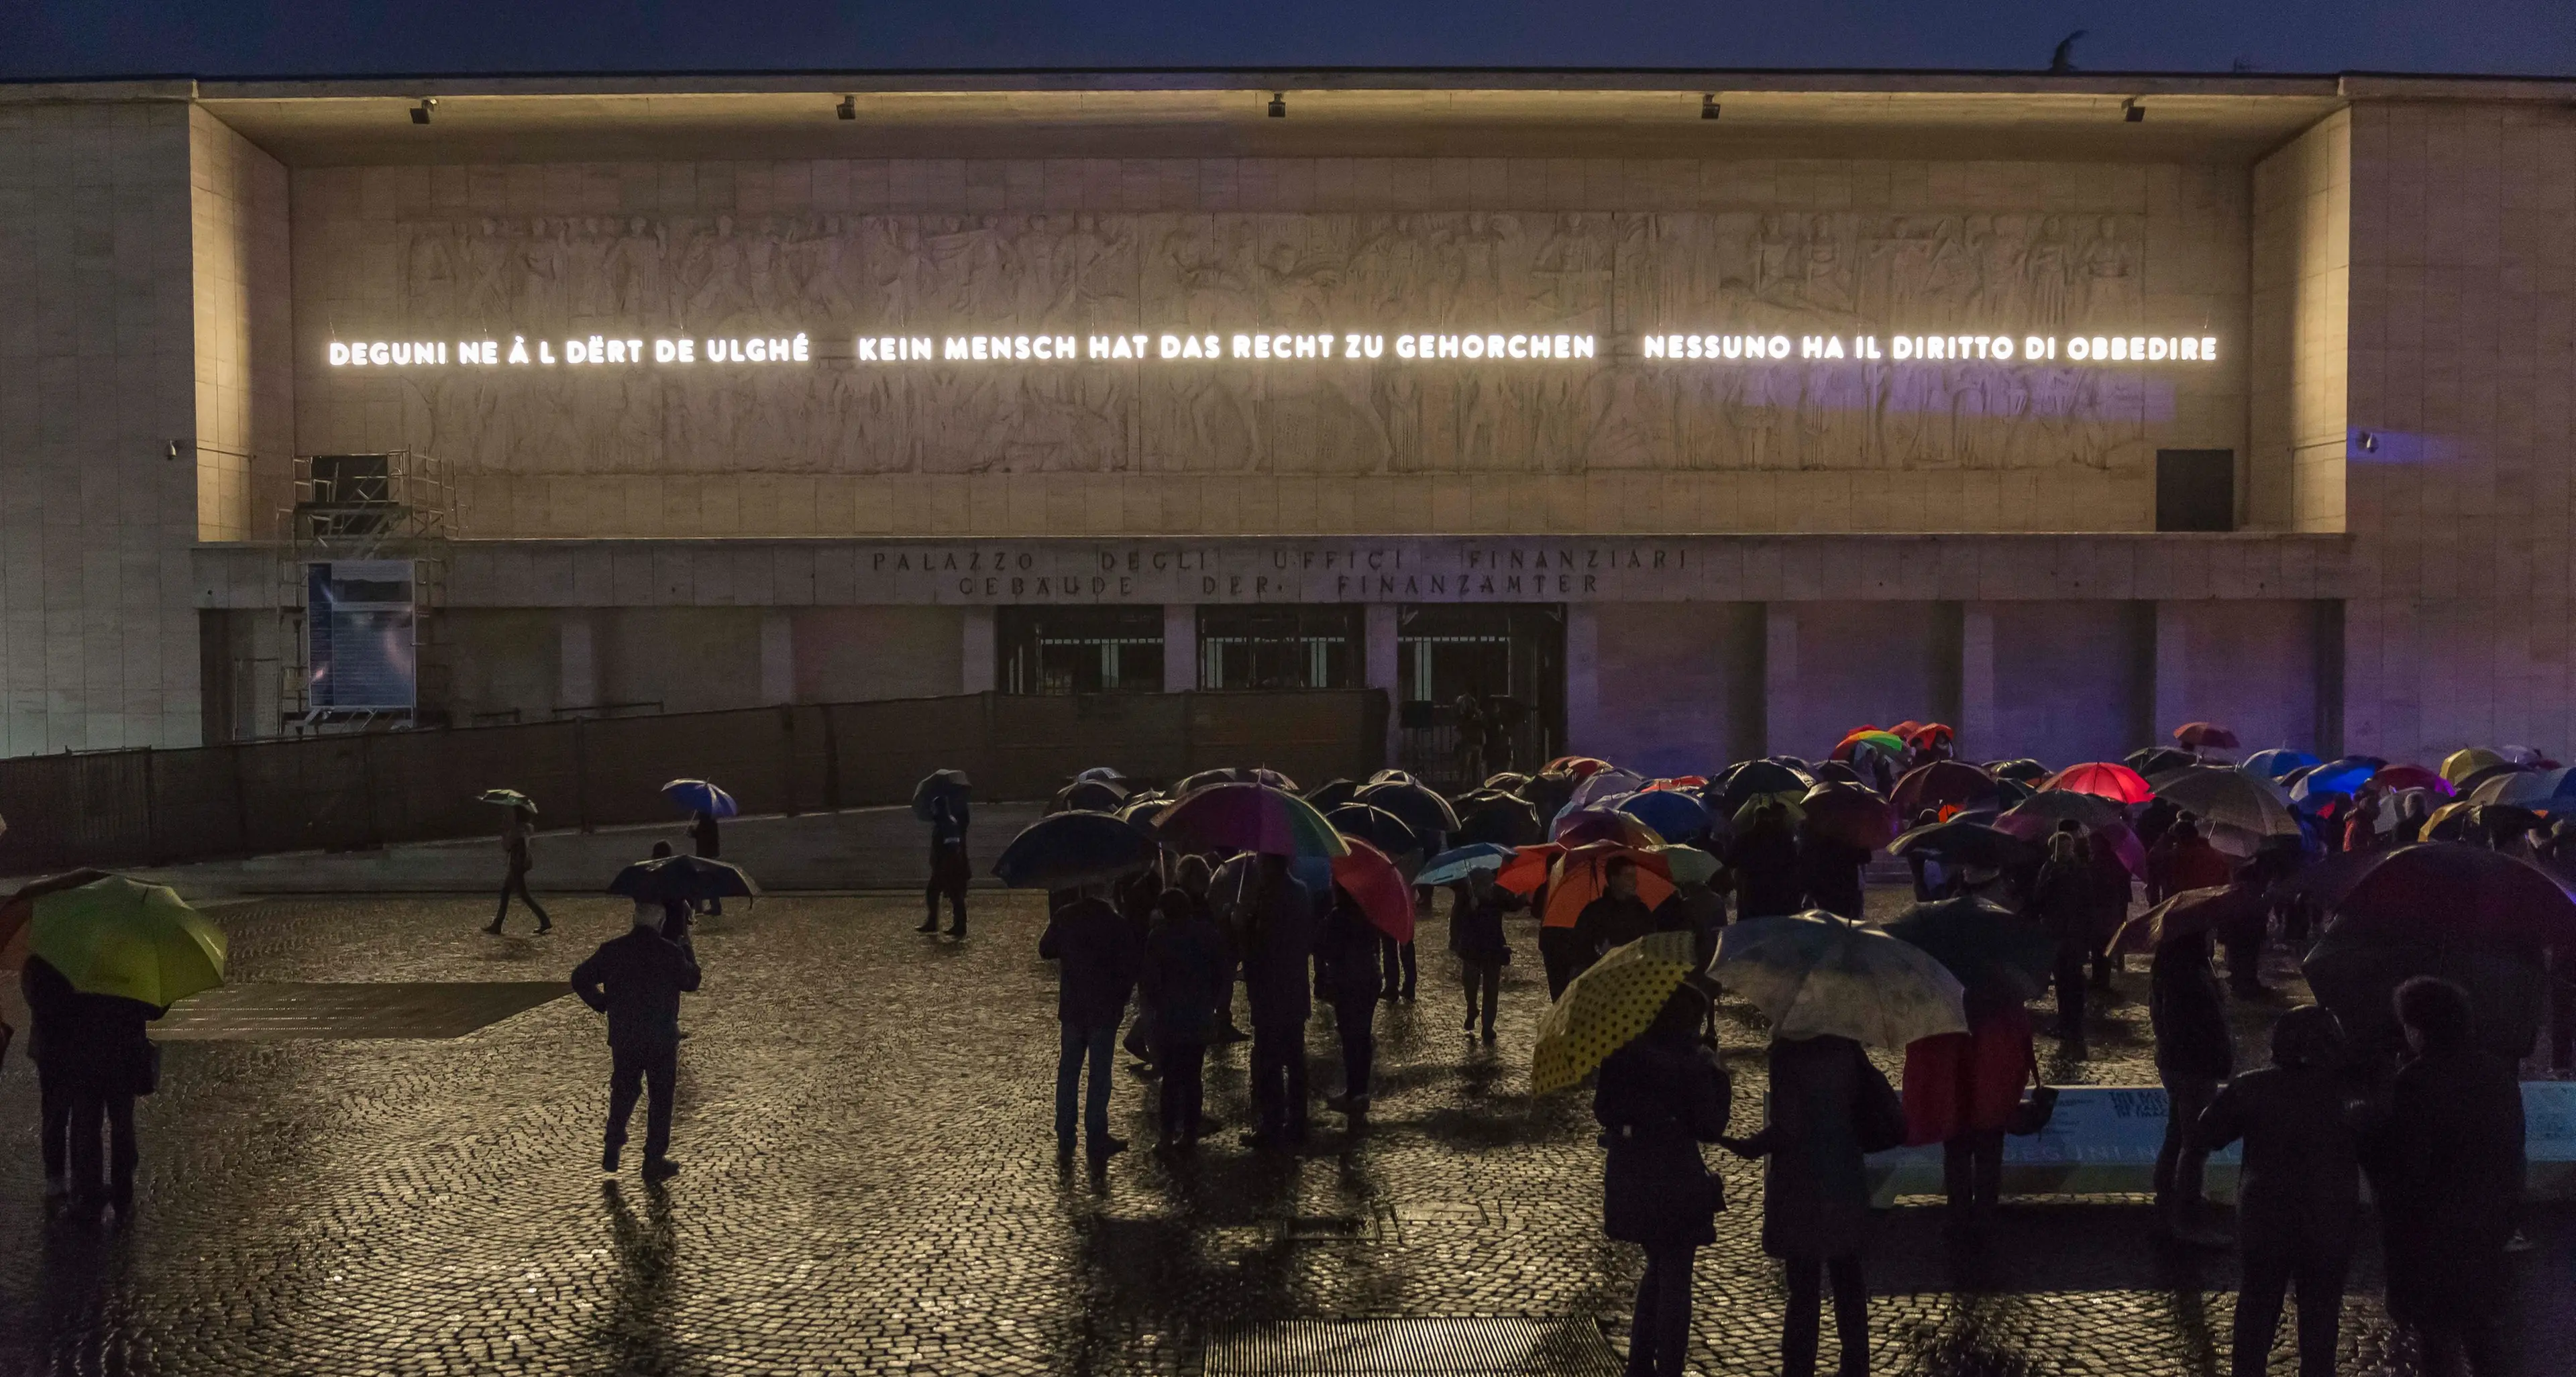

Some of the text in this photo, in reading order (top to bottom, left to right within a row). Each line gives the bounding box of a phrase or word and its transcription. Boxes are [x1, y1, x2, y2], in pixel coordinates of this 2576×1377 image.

[329, 332, 810, 366] DEGUNI NE À L DËRT DE ULGHÉ
[859, 333, 1595, 362] KEIN MENSCH HAT DAS RECHT ZU GEHORCHEN
[1644, 335, 2217, 362] NESSUNO HA IL DIRITTO DI OBBEDIRE
[873, 549, 1686, 571] PALAZZO DEGLI UFFICI FINANZIARI
